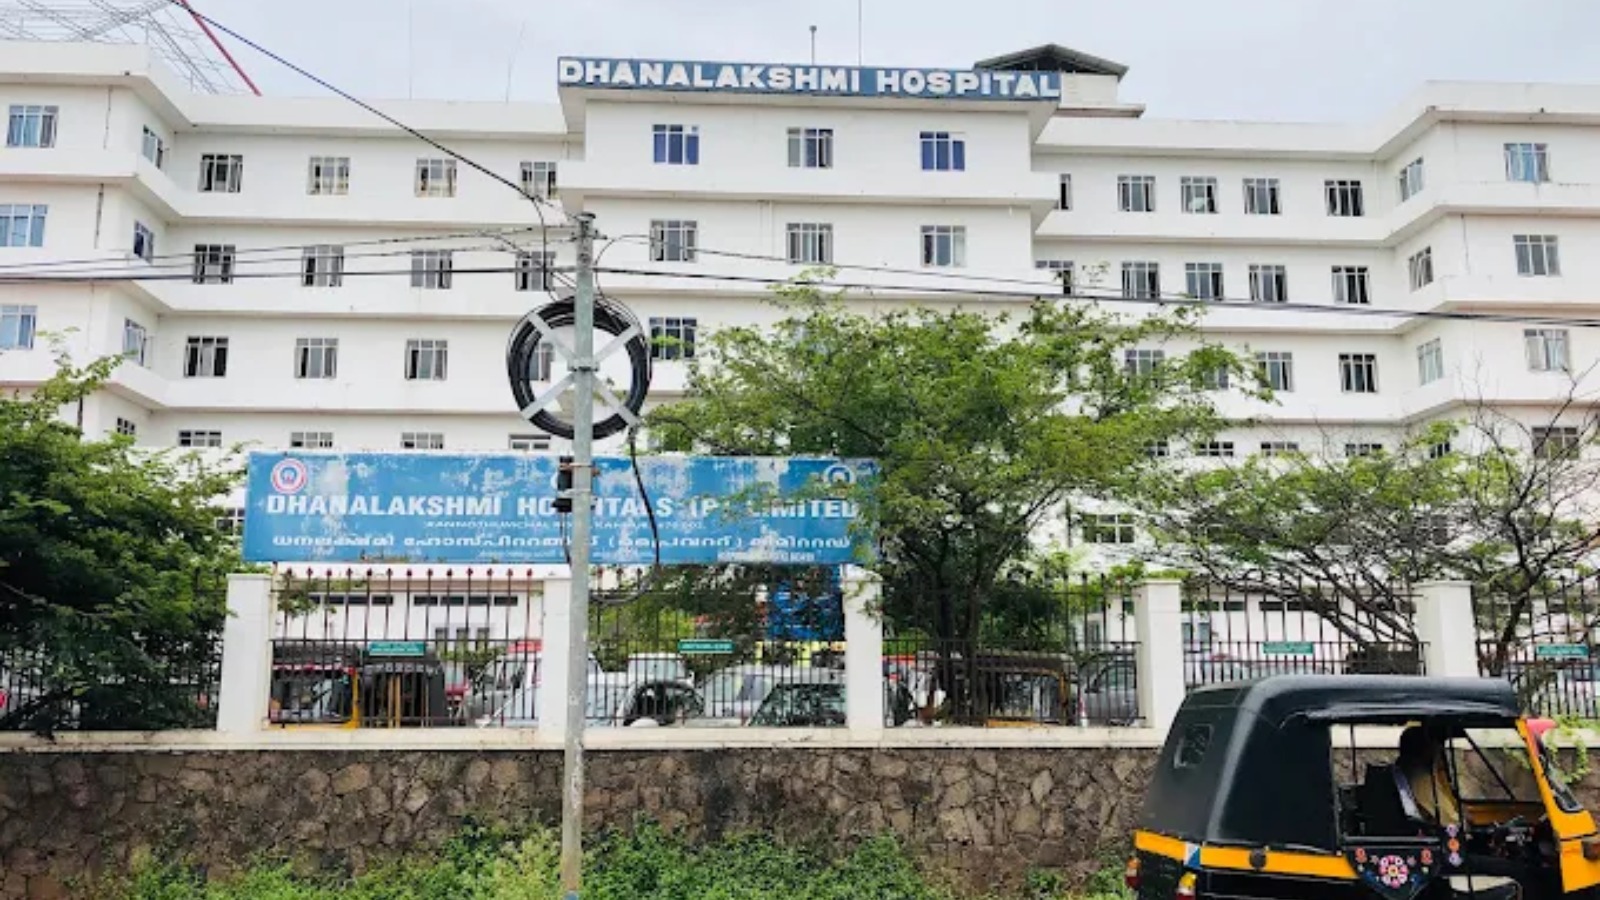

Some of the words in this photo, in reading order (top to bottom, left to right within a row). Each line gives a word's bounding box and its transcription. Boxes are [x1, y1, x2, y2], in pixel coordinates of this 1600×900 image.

[559, 59, 859, 92] DHANALAKSHMI
[876, 69, 1060, 97] HOSPITAL
[266, 494, 501, 515] DHANALAKSHMI
[517, 496, 673, 516] HOITALS
